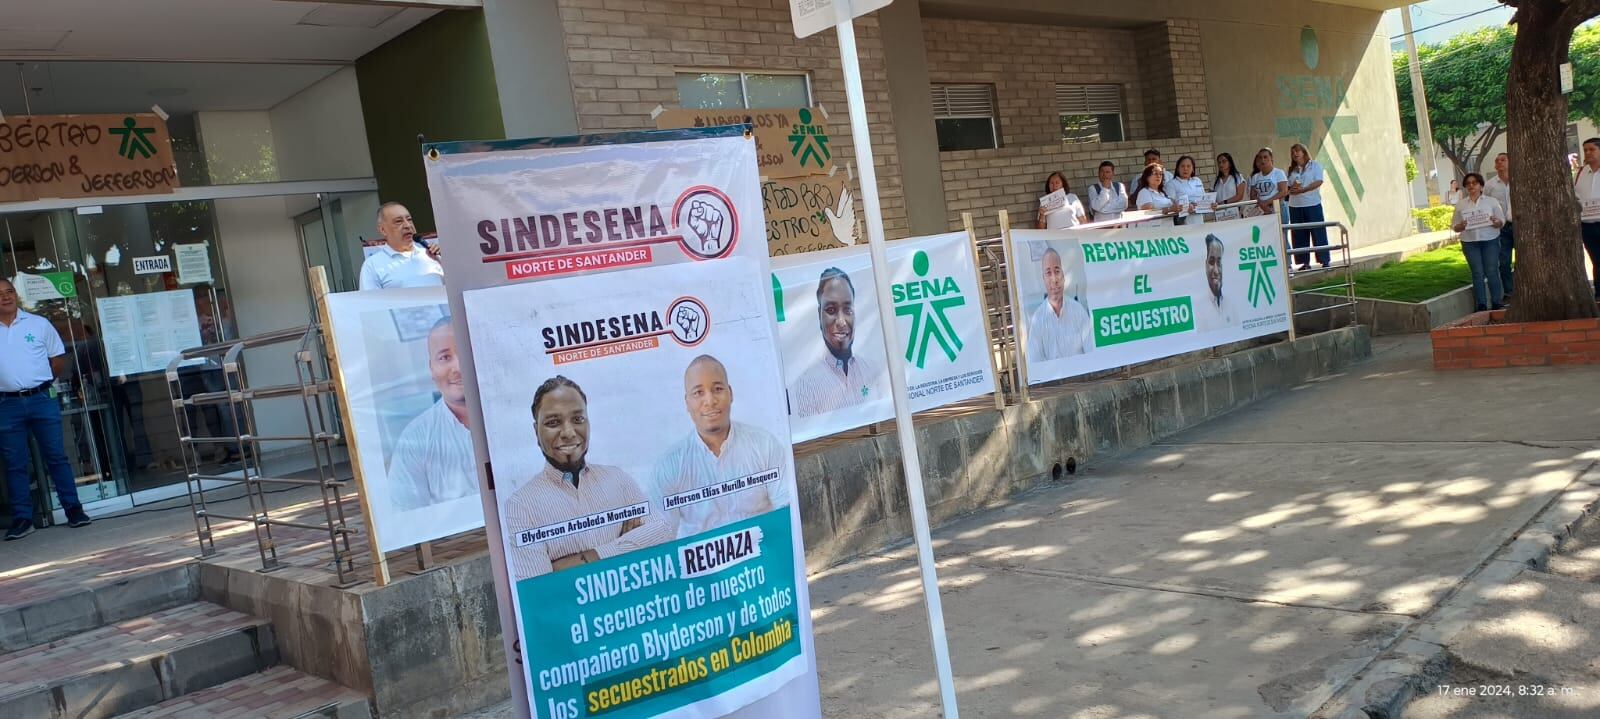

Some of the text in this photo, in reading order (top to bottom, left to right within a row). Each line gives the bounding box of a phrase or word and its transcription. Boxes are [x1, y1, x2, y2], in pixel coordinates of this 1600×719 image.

[1276, 75, 1350, 109] SENA
[774, 114, 789, 128] YA
[69, 155, 83, 175] &
[82, 165, 177, 193] JEFFERSON
[477, 204, 668, 255] SINDESENA
[135, 259, 168, 272] ENTRADA
[512, 250, 648, 276] NORTE DE SANTANDER
[1082, 237, 1189, 263] RECHAZAMOS
[1239, 245, 1276, 260] SENA
[892, 277, 960, 303] SENA
[1134, 275, 1152, 294] EL
[542, 311, 664, 348] SINDESENA
[1100, 304, 1189, 337] SECUESTRO
[558, 340, 654, 362] NORTE DE SANTANDER
[926, 385, 944, 395] NORTE
[954, 375, 984, 388] SANTANDER
[666, 472, 778, 508] Jefferson Elías Murillo Mosquera
[522, 506, 646, 543] Blyderson Arboleda Montañez
[575, 530, 753, 605] SINDESENA RECHAZA
[570, 564, 765, 644] el secuestro de nuestro
[540, 645, 640, 690] compañero
[642, 618, 724, 661] Blyderson
[728, 607, 736, 635] y
[740, 598, 757, 625] de
[762, 586, 792, 616] todos
[548, 620, 792, 719] los secuestrados en Colombia
